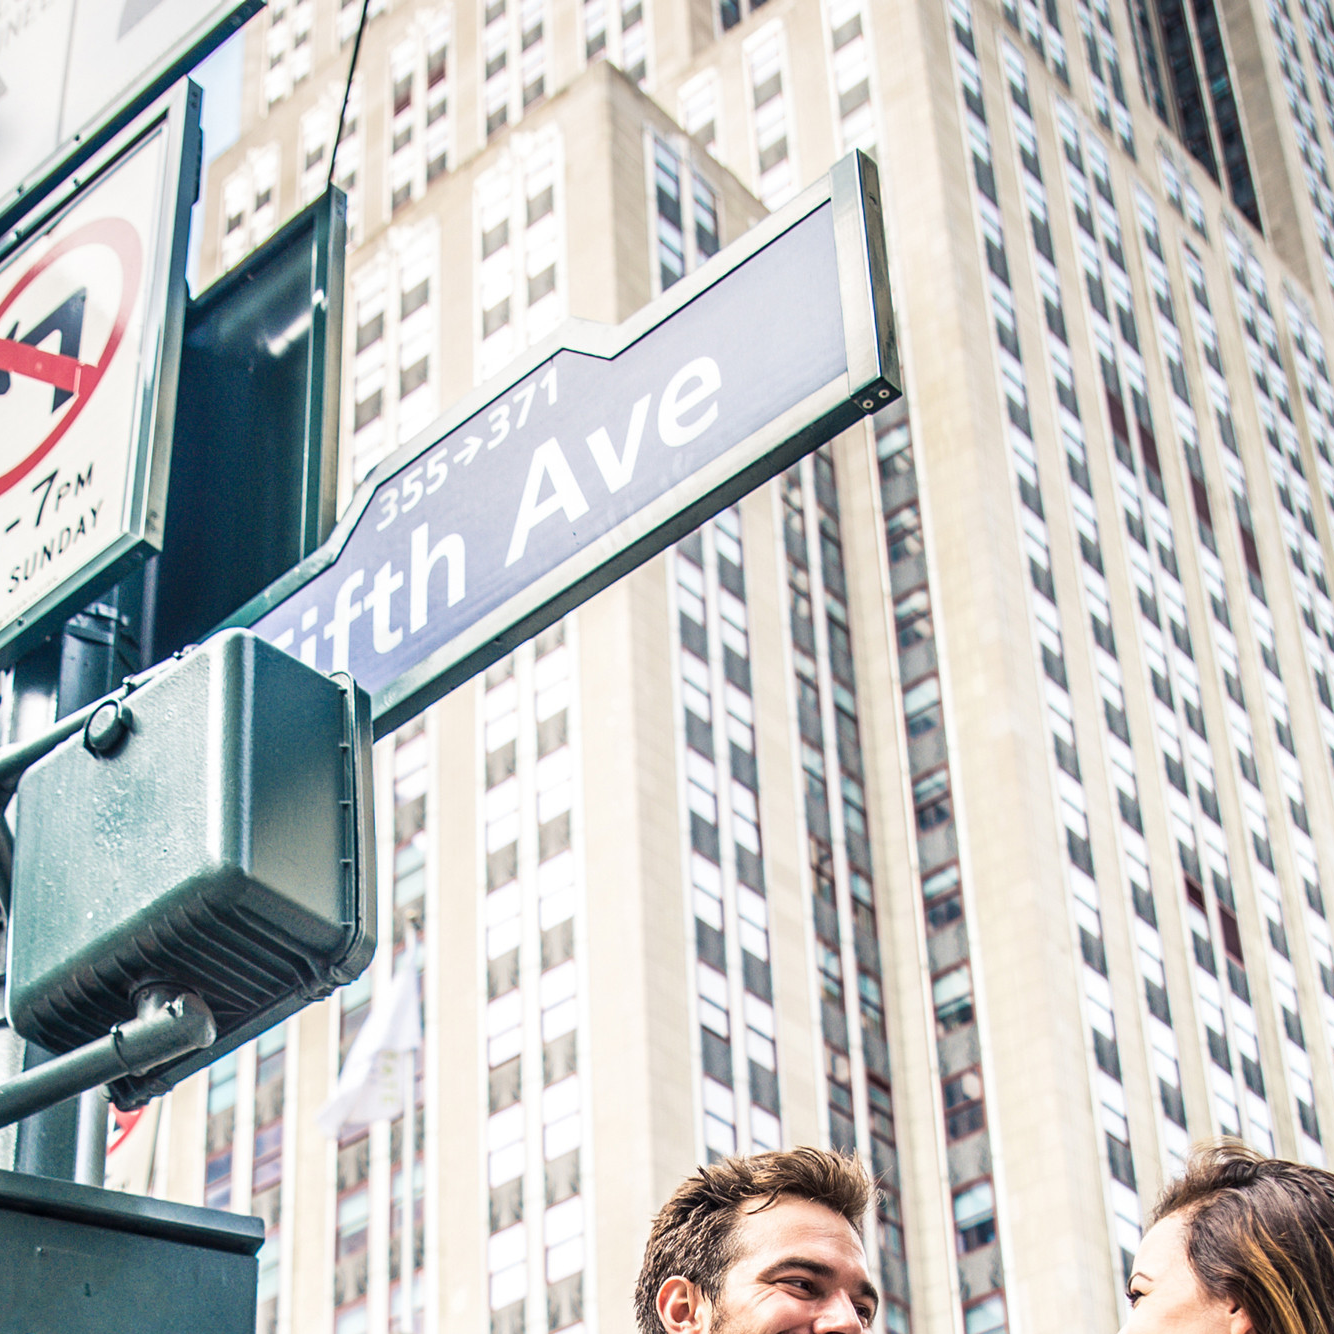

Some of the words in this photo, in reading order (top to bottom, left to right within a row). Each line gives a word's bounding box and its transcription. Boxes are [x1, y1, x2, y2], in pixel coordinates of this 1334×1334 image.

[269, 522, 466, 675] ifth
[504, 356, 722, 568] Ave
[376, 447, 449, 532] 355
[487, 365, 559, 451] 371
[7, 498, 104, 593] SUNDAY
